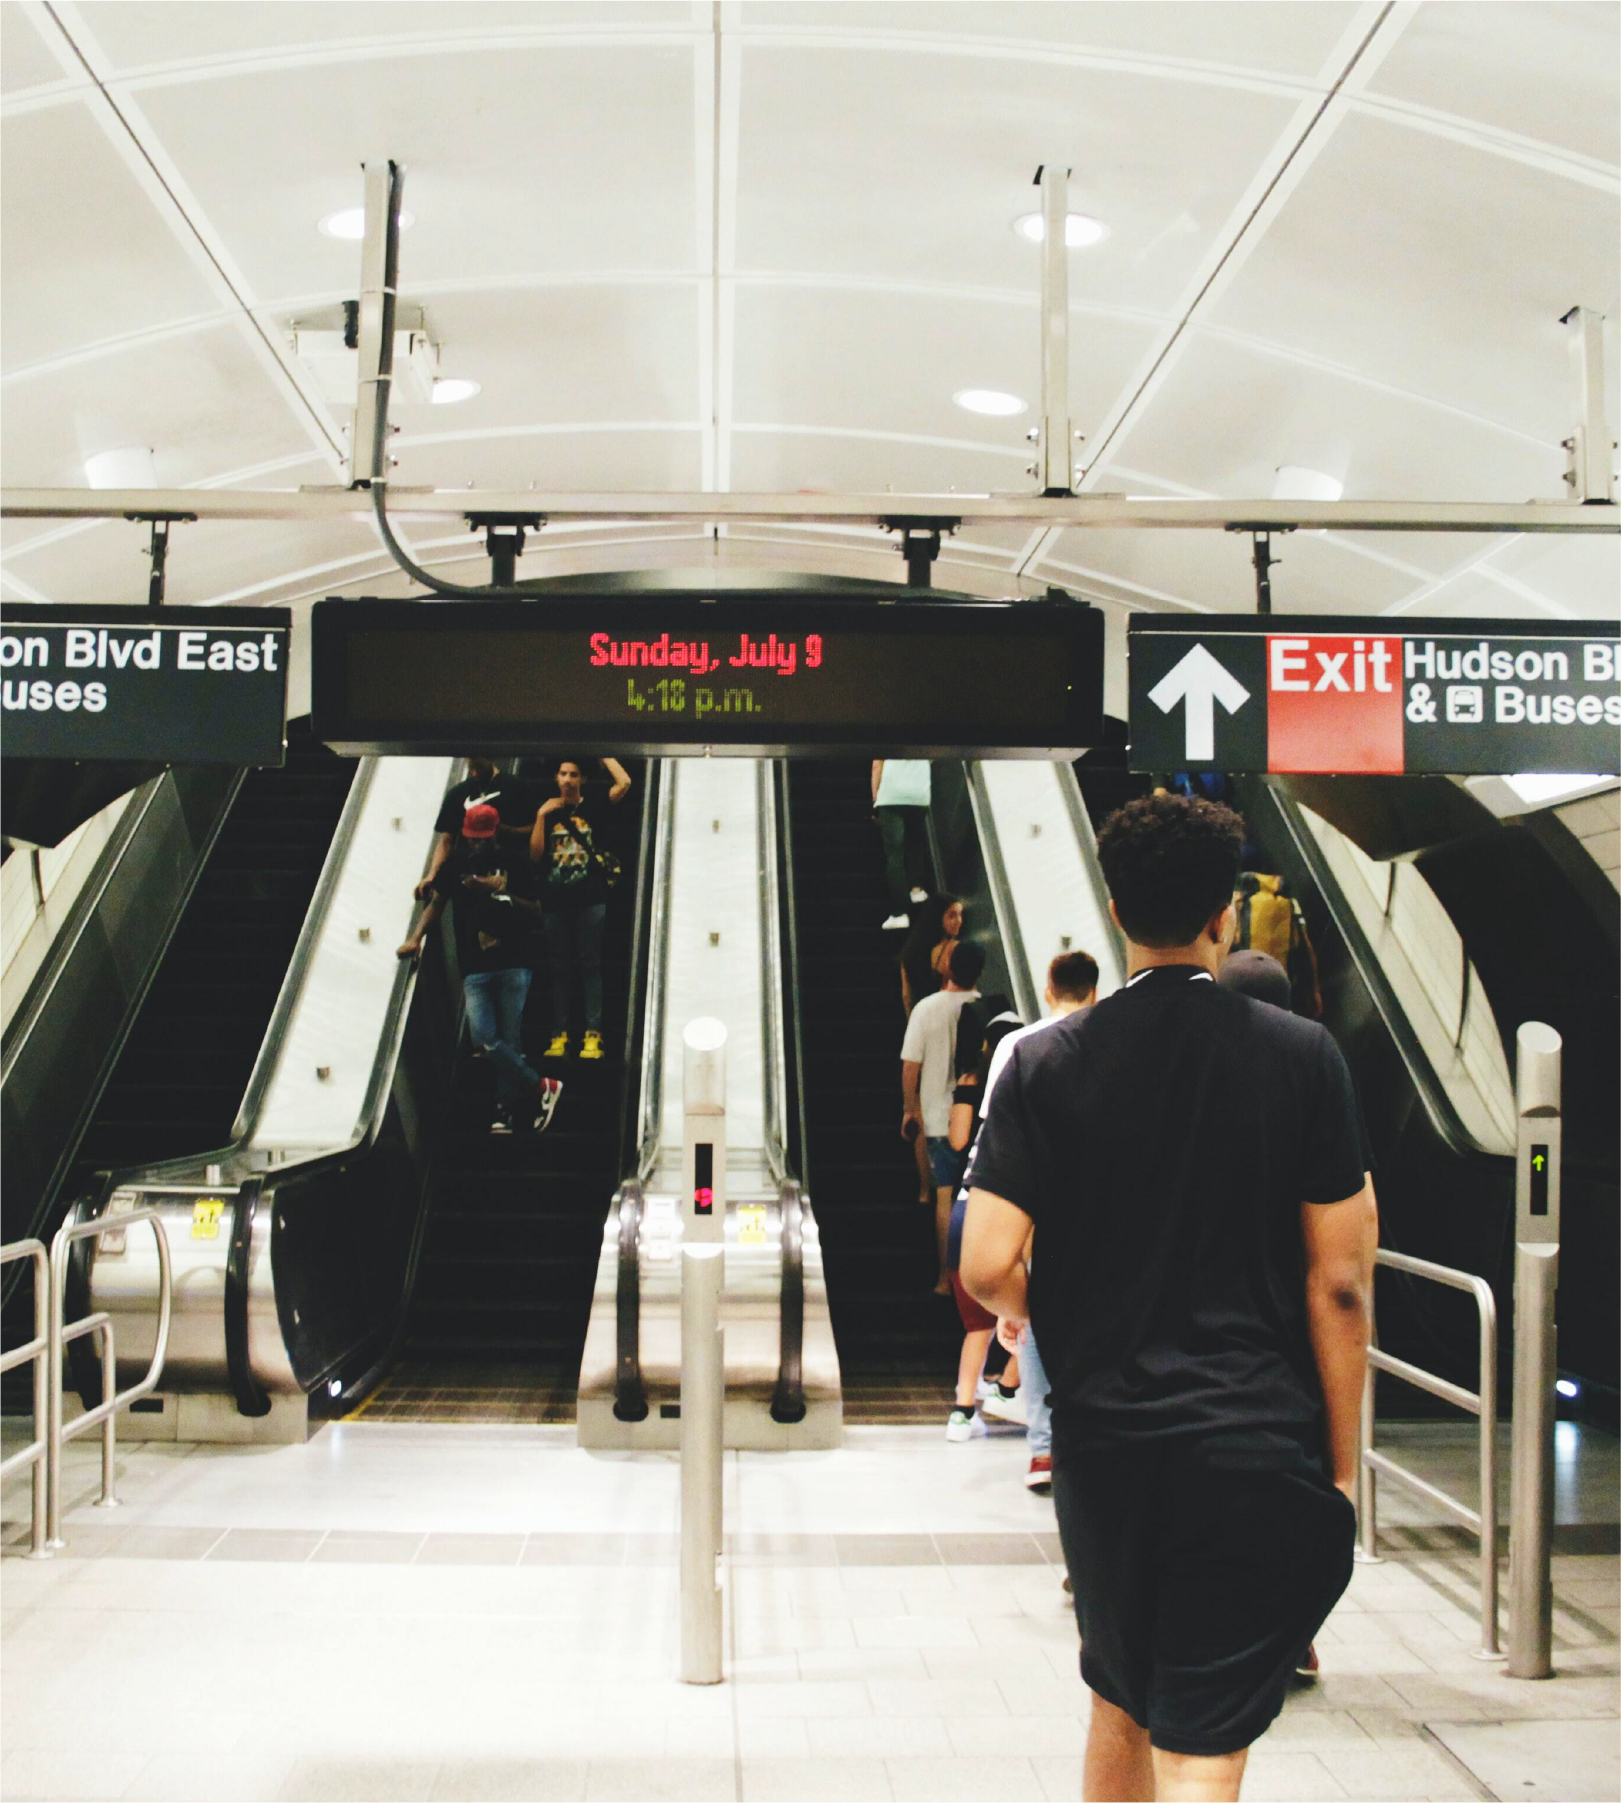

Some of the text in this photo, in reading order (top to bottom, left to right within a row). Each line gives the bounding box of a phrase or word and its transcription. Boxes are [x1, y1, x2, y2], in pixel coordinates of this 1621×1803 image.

[0, 630, 278, 672] on Blvd East
[590, 633, 822, 675] Sunday, July 9
[1270, 639, 1393, 693] Exit
[1404, 641, 1620, 681] Hudson Bl
[2, 680, 107, 713] uses
[627, 678, 762, 719] 4:18 p.m.
[1405, 683, 1620, 725] & Buses
